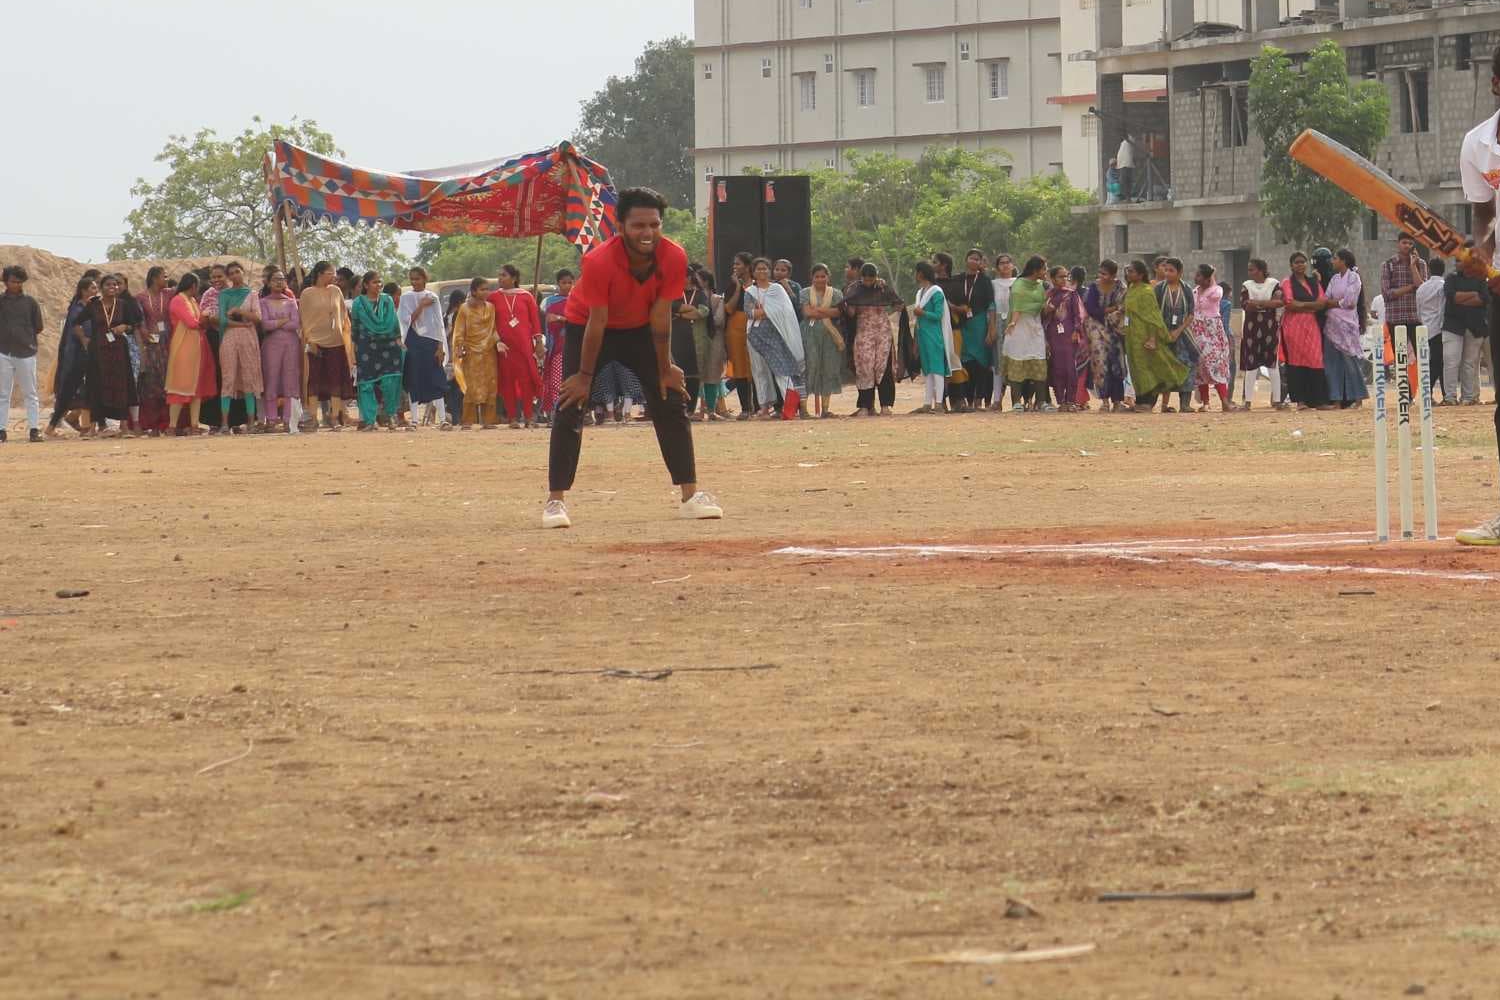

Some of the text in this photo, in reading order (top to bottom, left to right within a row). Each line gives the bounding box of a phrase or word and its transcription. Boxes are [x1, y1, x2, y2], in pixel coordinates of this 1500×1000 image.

[1375, 346, 1386, 421] STRIKER
[1397, 353, 1410, 426] STRIKER
[1420, 348, 1432, 421] STRIKER
